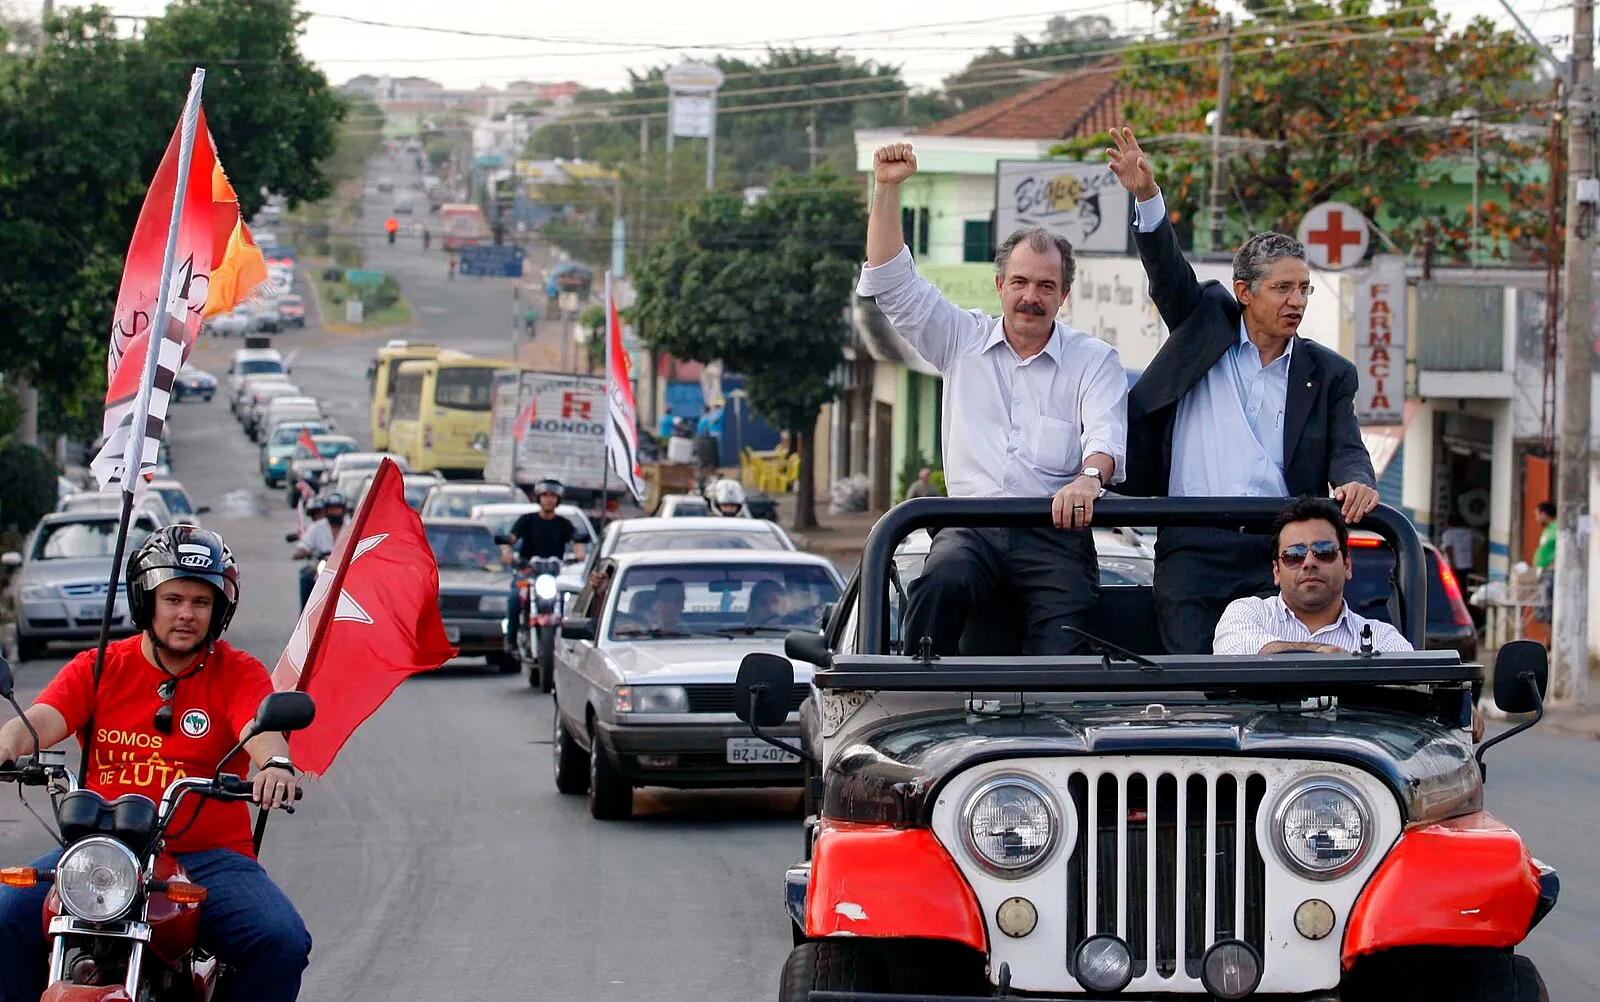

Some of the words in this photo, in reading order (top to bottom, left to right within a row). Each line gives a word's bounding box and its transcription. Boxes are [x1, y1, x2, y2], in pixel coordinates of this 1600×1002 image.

[1369, 284, 1391, 409] FARMACIA
[97, 728, 163, 748] SOMOS
[100, 770, 115, 785] DE
